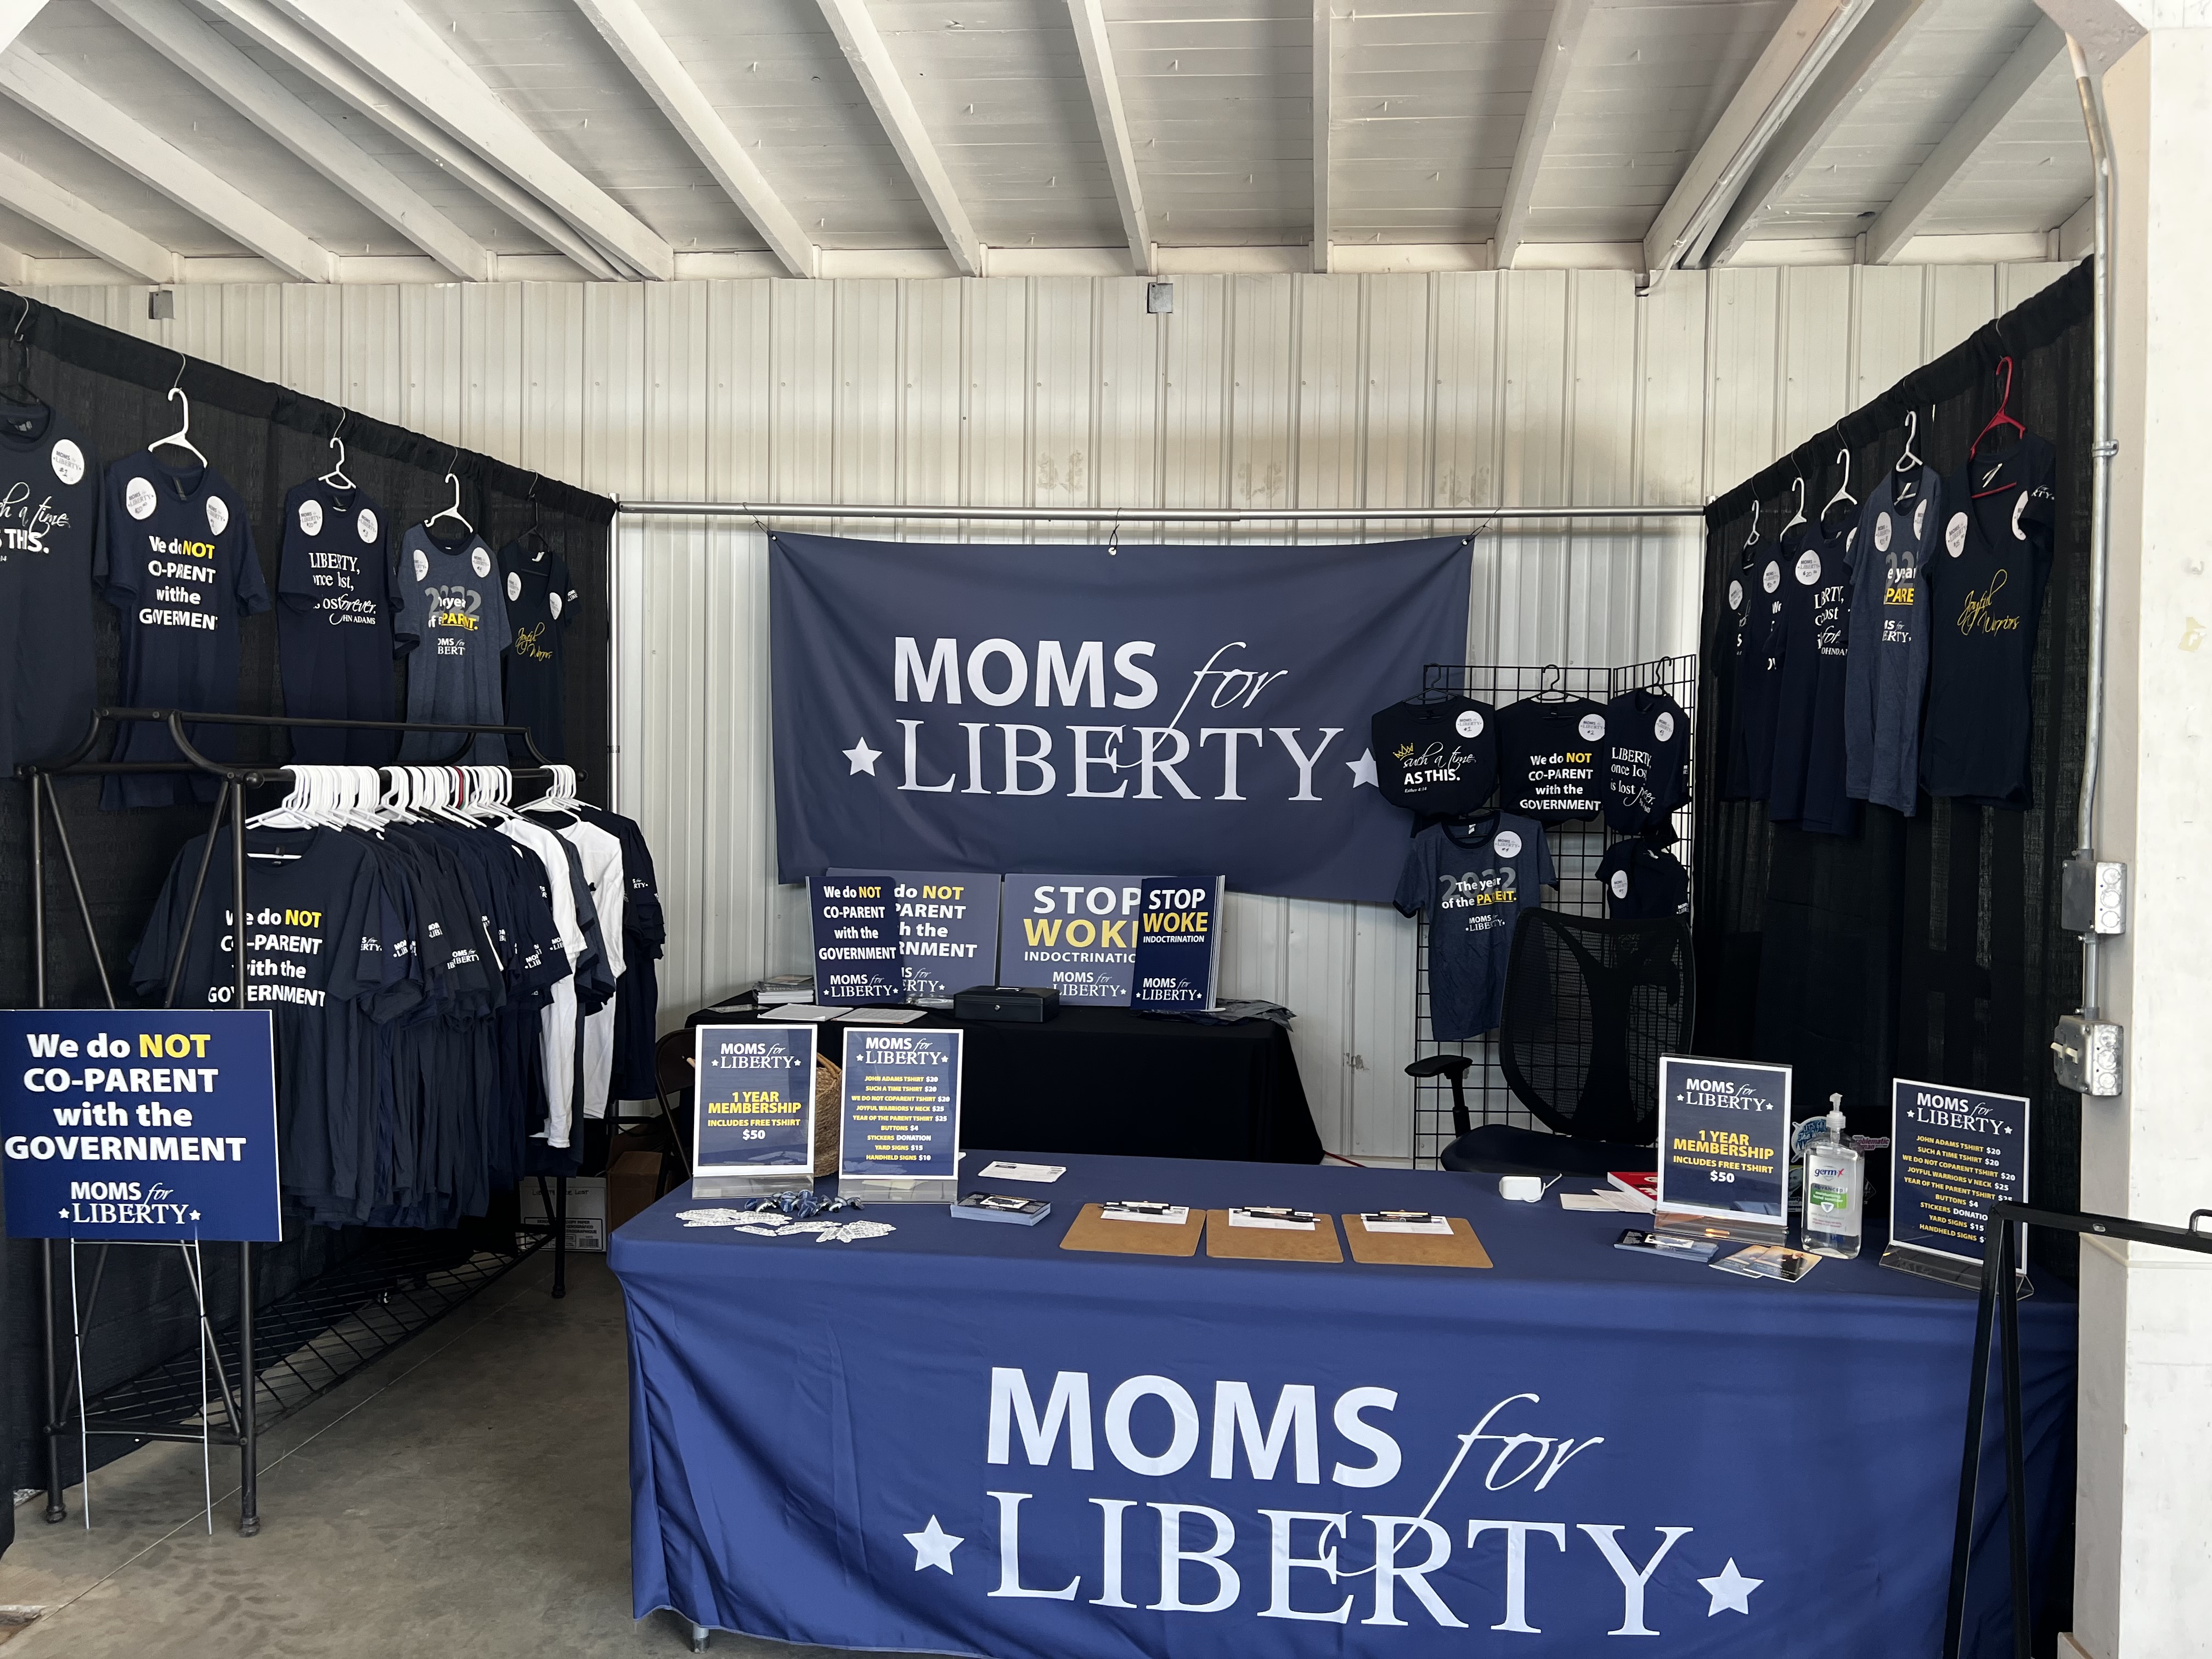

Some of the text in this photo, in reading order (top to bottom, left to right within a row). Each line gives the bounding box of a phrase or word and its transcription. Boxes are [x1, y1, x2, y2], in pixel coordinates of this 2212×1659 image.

[183, 540, 215, 559] NOT
[353, 616, 376, 624] ADAMS
[894, 636, 1288, 769] MOMS for
[895, 719, 1344, 800] LIBERTY
[1403, 742, 1476, 772] such a time
[1530, 753, 1592, 765] We do NOT
[1404, 769, 1460, 785] AS THIS.
[1528, 769, 1593, 781] CO-PARENT
[1611, 764, 1629, 775] once
[1536, 784, 1583, 794] with the
[1611, 778, 1635, 794] is lost
[1520, 799, 1601, 811] GOVERNMENT
[823, 886, 881, 898] We do NOT
[894, 884, 964, 900] do NOT
[1455, 878, 1501, 891] The year
[1034, 886, 1142, 915] STOP
[1149, 889, 1205, 910] STOP
[1442, 898, 1453, 909] of
[1456, 897, 1475, 907] the
[257, 908, 321, 928] do NOT
[823, 907, 885, 918] CO-PARENT
[1469, 915, 1491, 924] MOMS
[916, 923, 948, 938] the
[1143, 912, 1209, 933] WOKE
[834, 927, 878, 939] with the
[221, 934, 322, 955] C-PARENT
[819, 947, 896, 960] GOVERNMENT
[281, 960, 306, 978] the
[913, 968, 931, 980] for
[830, 974, 884, 992] MOMS for
[1053, 972, 1093, 983] MOMS
[1143, 978, 1176, 988] MOMS
[208, 985, 325, 1007] GOERNMENT
[831, 985, 893, 997] LIBERTY
[1142, 989, 1197, 1001] LIBERTY
[27, 1033, 211, 1058] We do NOT
[721, 1043, 786, 1064] MOMS for
[866, 1037, 933, 1059] MOMS for
[721, 1056, 794, 1069] LIBERTY
[866, 1051, 941, 1064] LIBERTY
[23, 1068, 218, 1092] CO-PARENT
[732, 1092, 779, 1102] 1 YEAR
[1686, 1078, 1757, 1105] MOMS for
[708, 1103, 802, 1114] MEMBERSHIP
[1686, 1092, 1766, 1111] LIBERTY
[1917, 1092, 1994, 1124] MOMS for
[53, 1102, 192, 1127] with the
[1917, 1108, 2005, 1136] LIBERTY
[742, 1129, 765, 1141] $50
[1699, 1130, 1750, 1146] 1 YEAR
[4, 1136, 246, 1161] GOVERNMENT
[1674, 1138, 1774, 1160] MEMBERSHIP
[1673, 1155, 1773, 1173] INCLUDES FREE TSHIRT
[1959, 1154, 1982, 1163] TSHIRT
[1985, 1158, 2000, 1166] $20
[1710, 1170, 1735, 1183] $50
[1908, 1167, 1932, 1176] JOYFUL
[1933, 1171, 1967, 1183] WARRIORS
[1974, 1179, 1991, 1188] NECK
[1904, 1177, 1921, 1185] YEAR
[1945, 1185, 1971, 1195] PARENT
[1972, 1190, 1995, 1199] TSHIRT
[71, 1182, 173, 1216] MOMS for
[1936, 1194, 1966, 1205] BUTTONS
[72, 1204, 189, 1224] LIBERTY
[1920, 1202, 1988, 1221] STICKERS DONATIO
[1929, 1215, 1984, 1231] YARD SIGNS $15
[986, 1366, 1604, 1576] MOMS for
[986, 1490, 1694, 1635] LIBERTY
